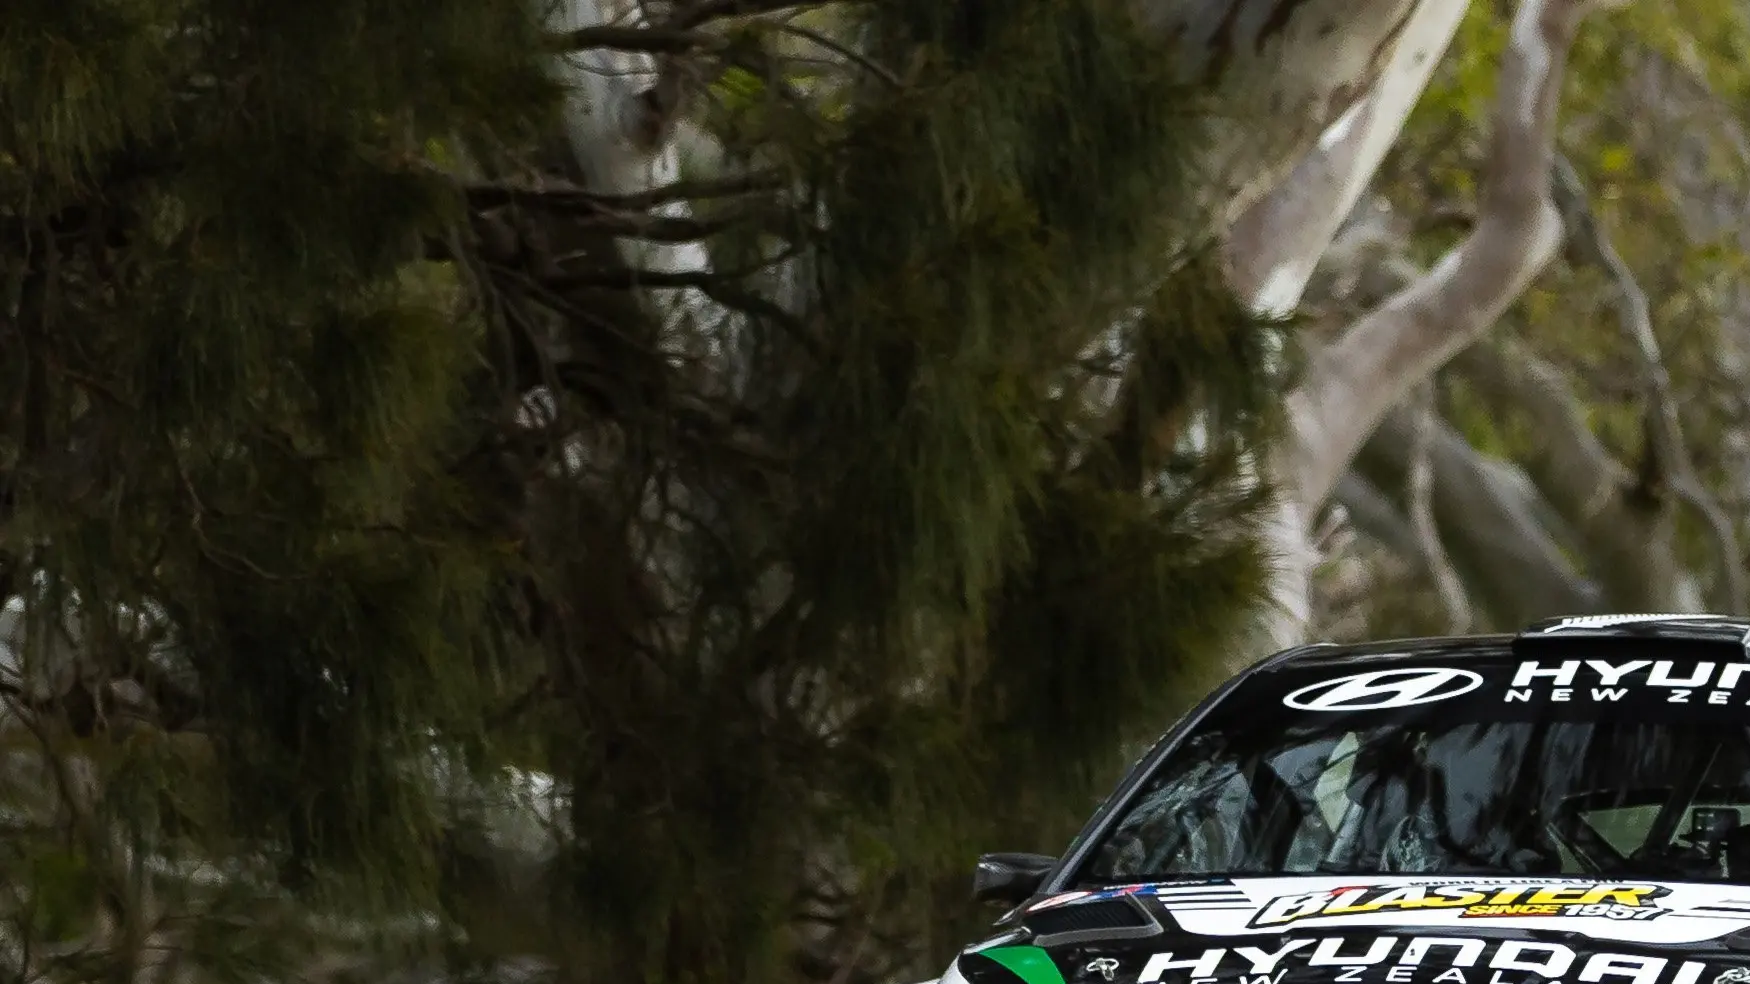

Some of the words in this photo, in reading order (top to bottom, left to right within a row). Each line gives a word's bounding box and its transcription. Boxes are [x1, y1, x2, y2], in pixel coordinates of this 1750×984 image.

[1503, 688, 1629, 703] NEW
[1464, 903, 1559, 916] SINCE
[1563, 903, 1669, 921] 1957
